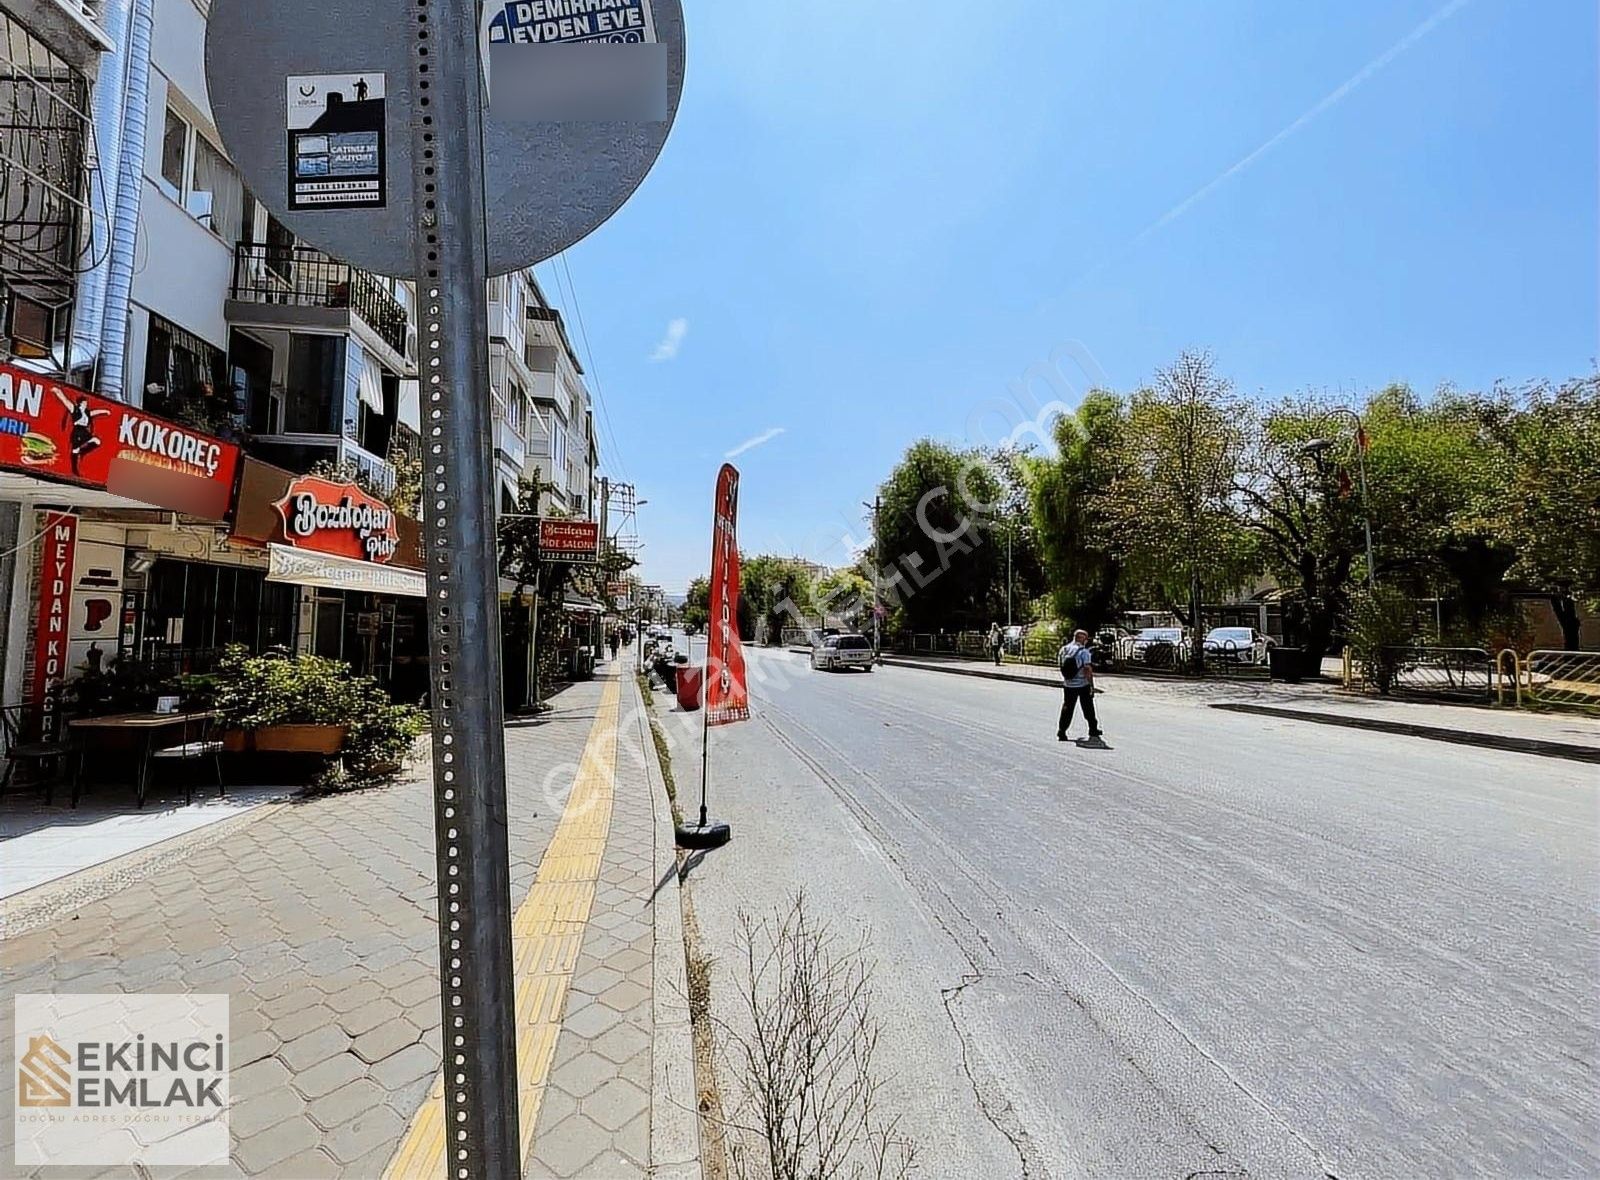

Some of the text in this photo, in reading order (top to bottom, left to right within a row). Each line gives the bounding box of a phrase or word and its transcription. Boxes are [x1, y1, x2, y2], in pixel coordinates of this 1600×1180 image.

[513, 7, 642, 43] EVDEN EVE
[516, 0, 635, 24] DEMİRH
[0, 373, 43, 417] AN
[119, 414, 220, 477] KOKOREÇ
[40, 524, 70, 768] MEYDAN KOKOR
